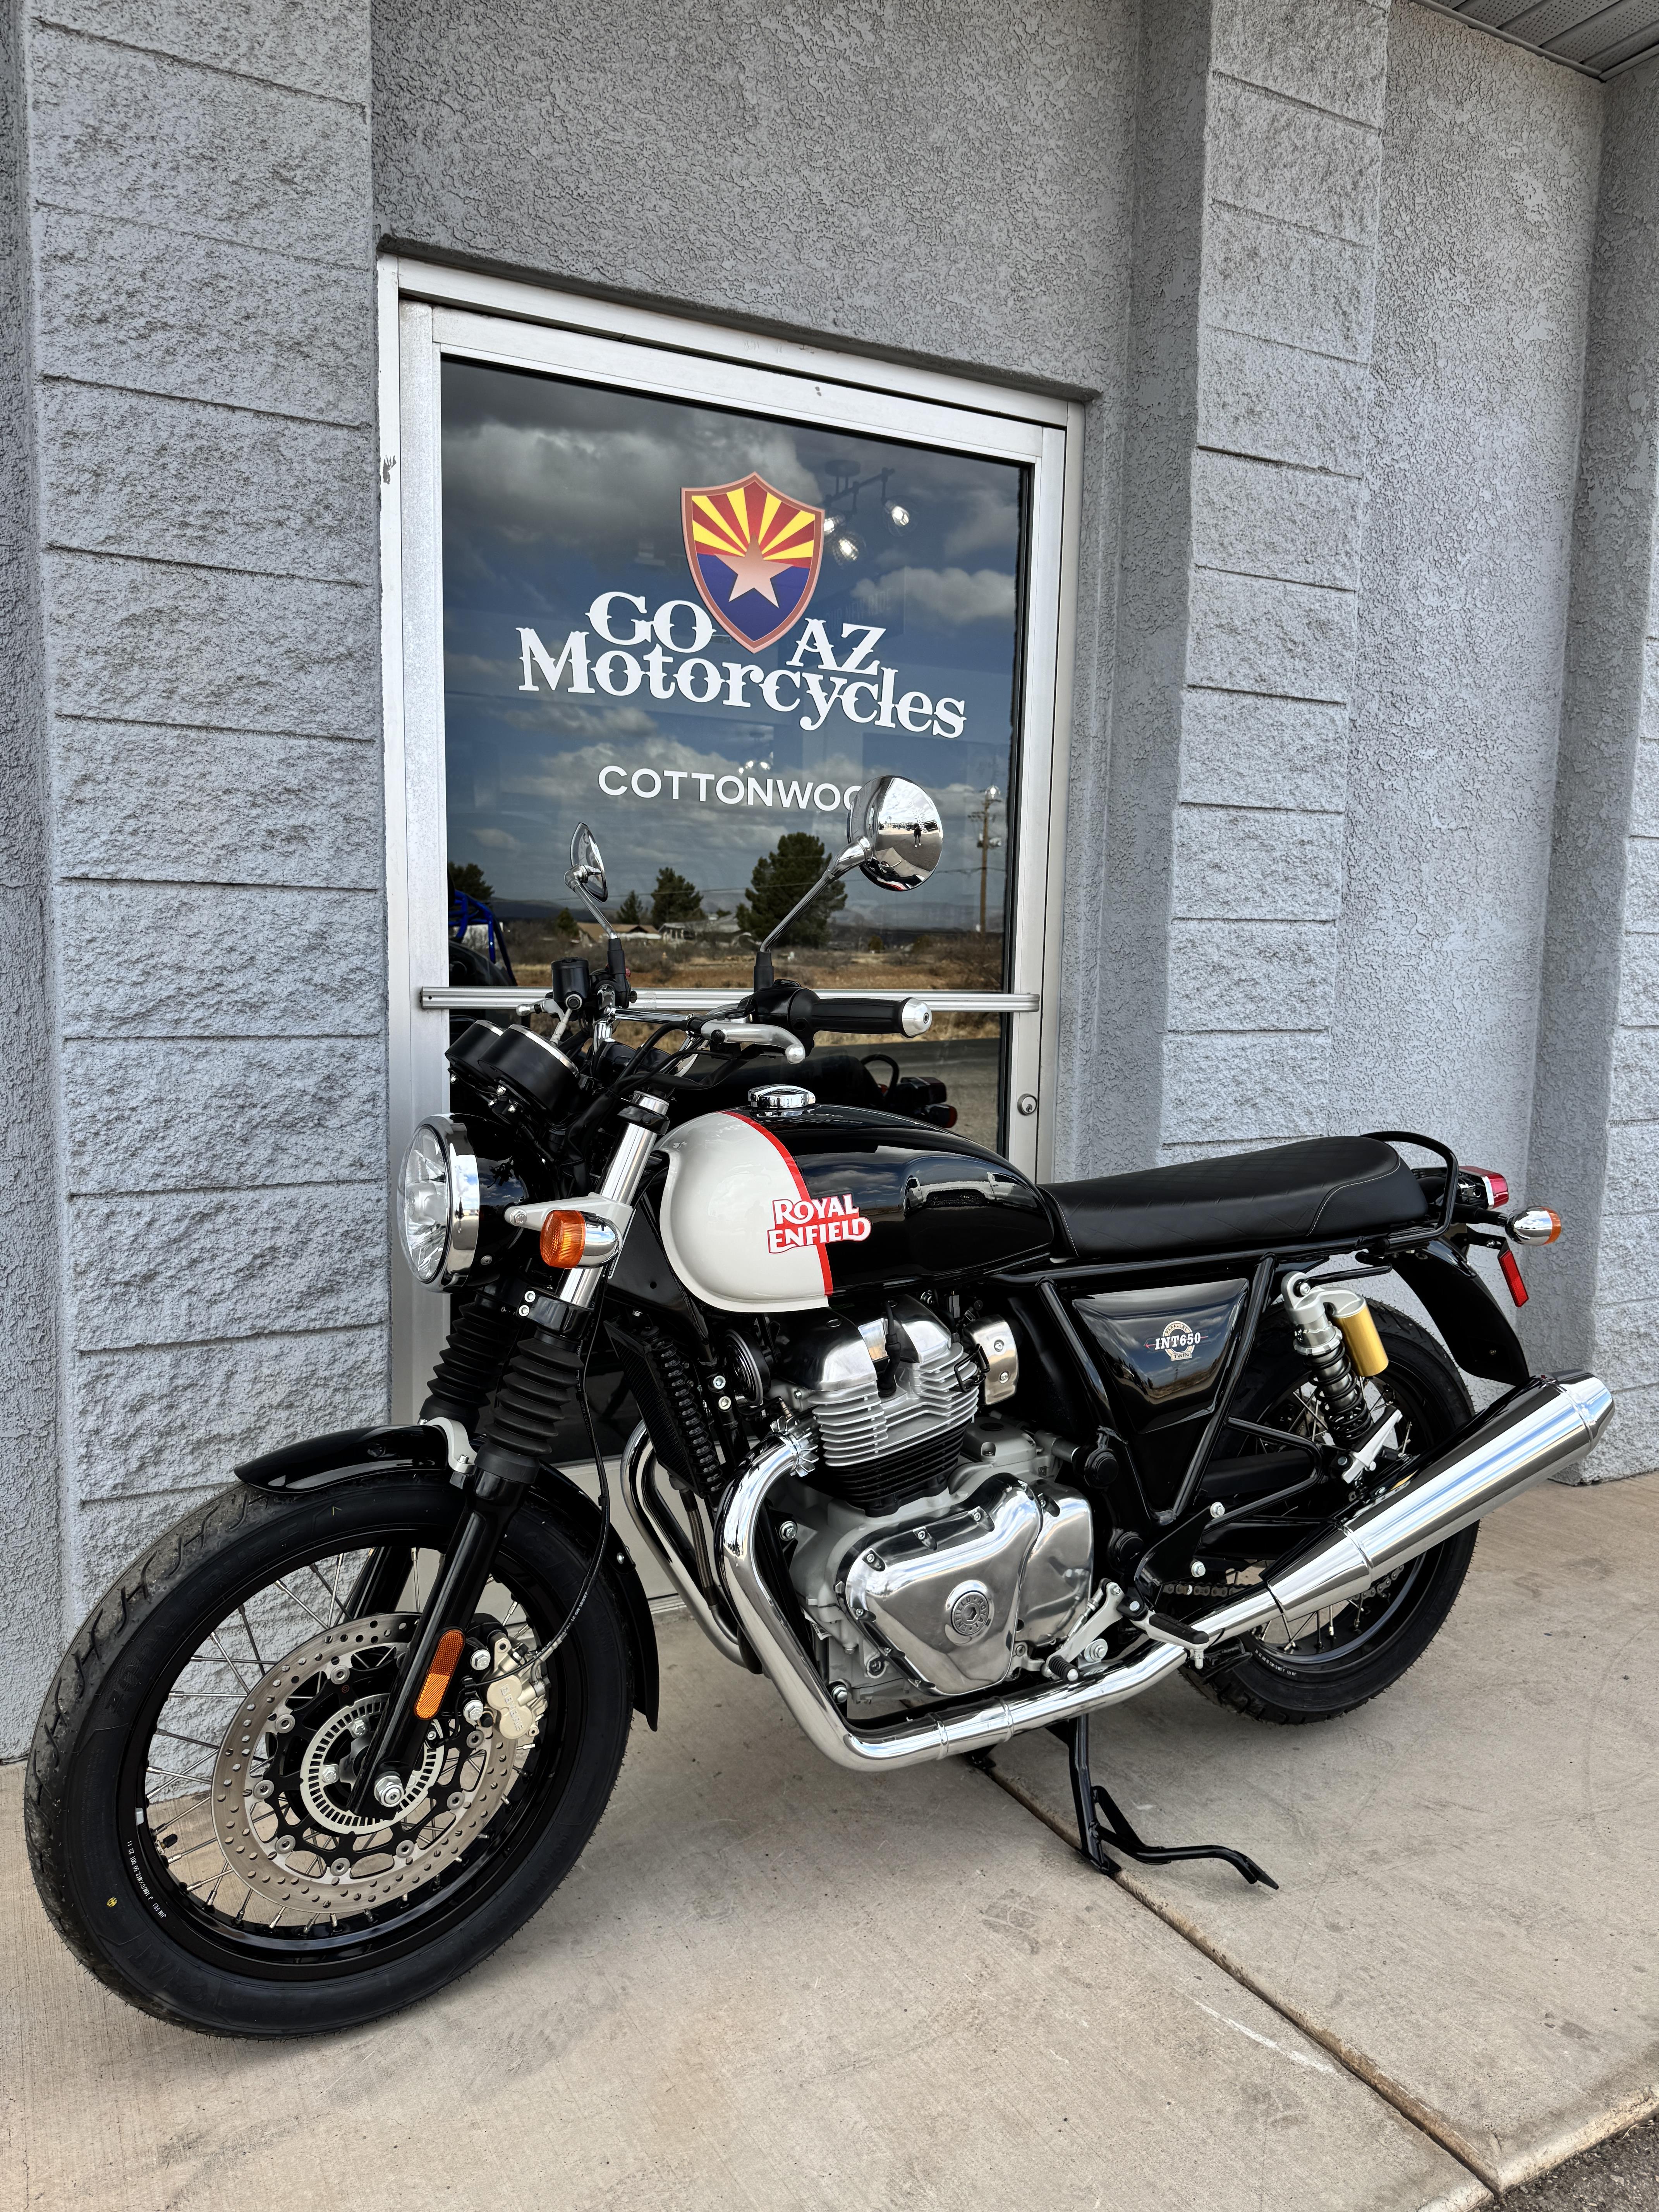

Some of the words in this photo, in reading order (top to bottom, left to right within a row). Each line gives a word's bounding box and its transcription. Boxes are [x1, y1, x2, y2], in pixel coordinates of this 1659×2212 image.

[585, 591, 716, 653] GO
[786, 618, 886, 675] AZ
[515, 627, 967, 738] Motorcycles
[775, 1194, 859, 1224] ROYAL
[768, 1217, 871, 1253] ENFIELD
[1155, 1332, 1201, 1350] INT650
[1166, 1324, 1188, 1334] PARALLEL
[955, 1597, 971, 1632] ENFIELD
[974, 1598, 987, 1629] ROYAL
[152, 1903, 160, 1912] FEI
[158, 1910, 167, 1918] JIN
